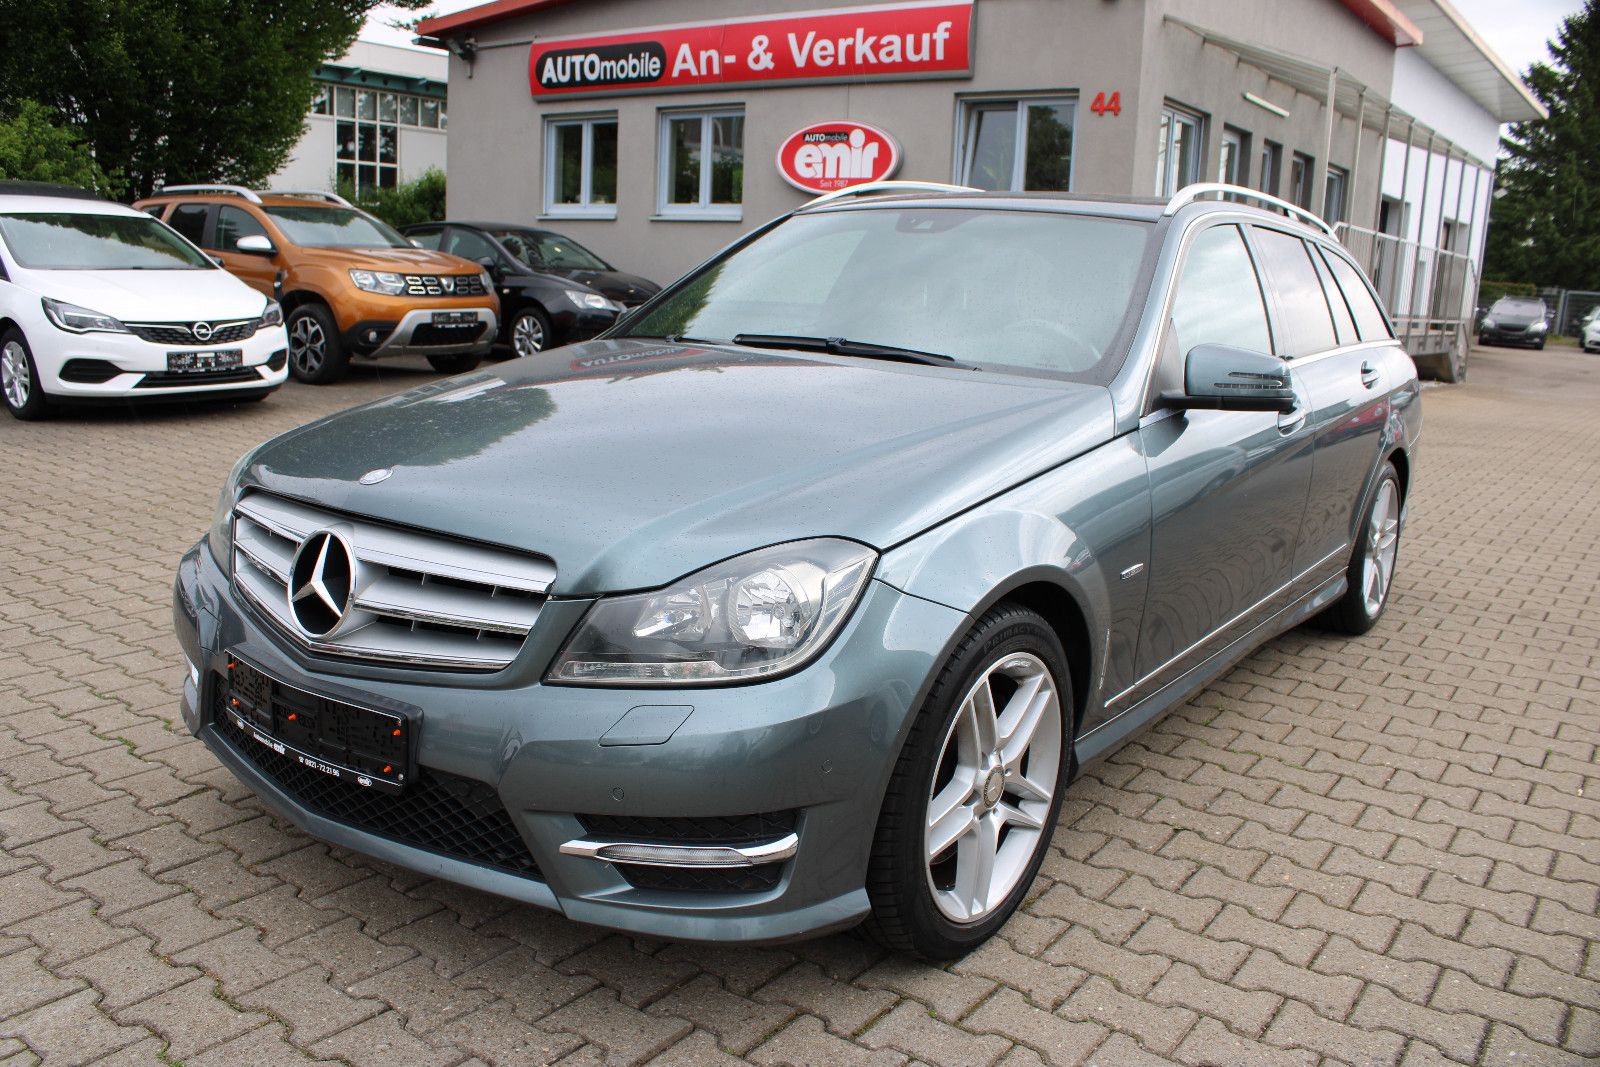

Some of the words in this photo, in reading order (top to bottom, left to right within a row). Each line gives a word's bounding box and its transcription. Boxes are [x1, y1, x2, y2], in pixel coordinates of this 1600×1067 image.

[541, 52, 661, 84] AUTOmobile
[671, 43, 737, 78] An-
[747, 34, 775, 71] &
[787, 21, 952, 68] Verkauf
[1091, 91, 1121, 116] 44
[804, 132, 848, 142] AUTOmobile
[794, 128, 879, 179] emir
[820, 179, 832, 188] Seit
[834, 179, 849, 188] 1987
